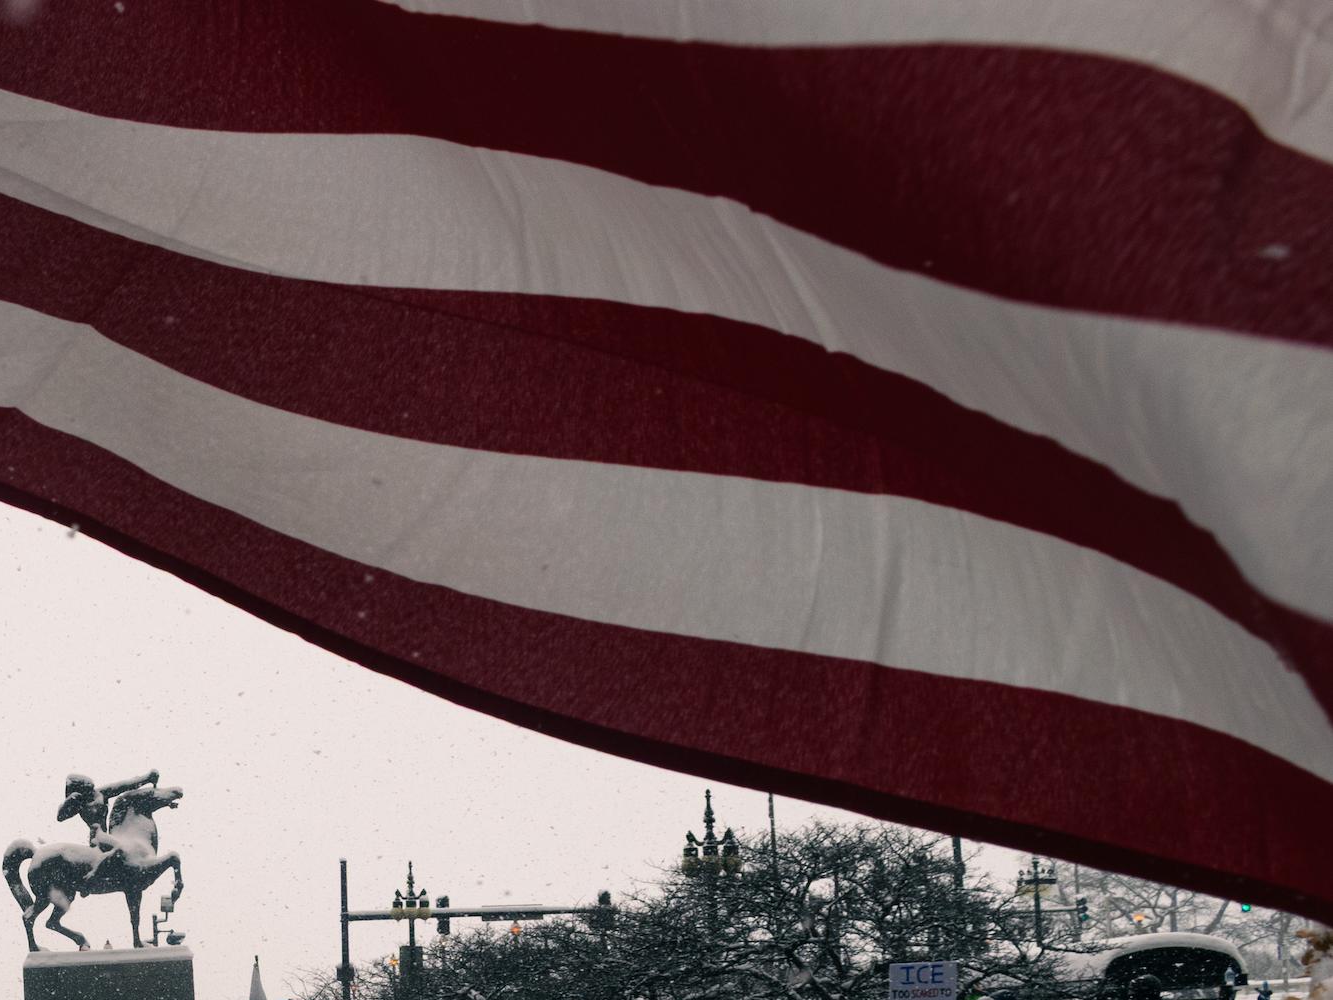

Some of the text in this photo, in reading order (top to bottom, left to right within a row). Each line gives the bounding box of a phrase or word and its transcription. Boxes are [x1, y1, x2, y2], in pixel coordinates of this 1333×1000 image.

[900, 964, 944, 984] ICE
[892, 990, 910, 999] TOO
[939, 988, 952, 997] TO
